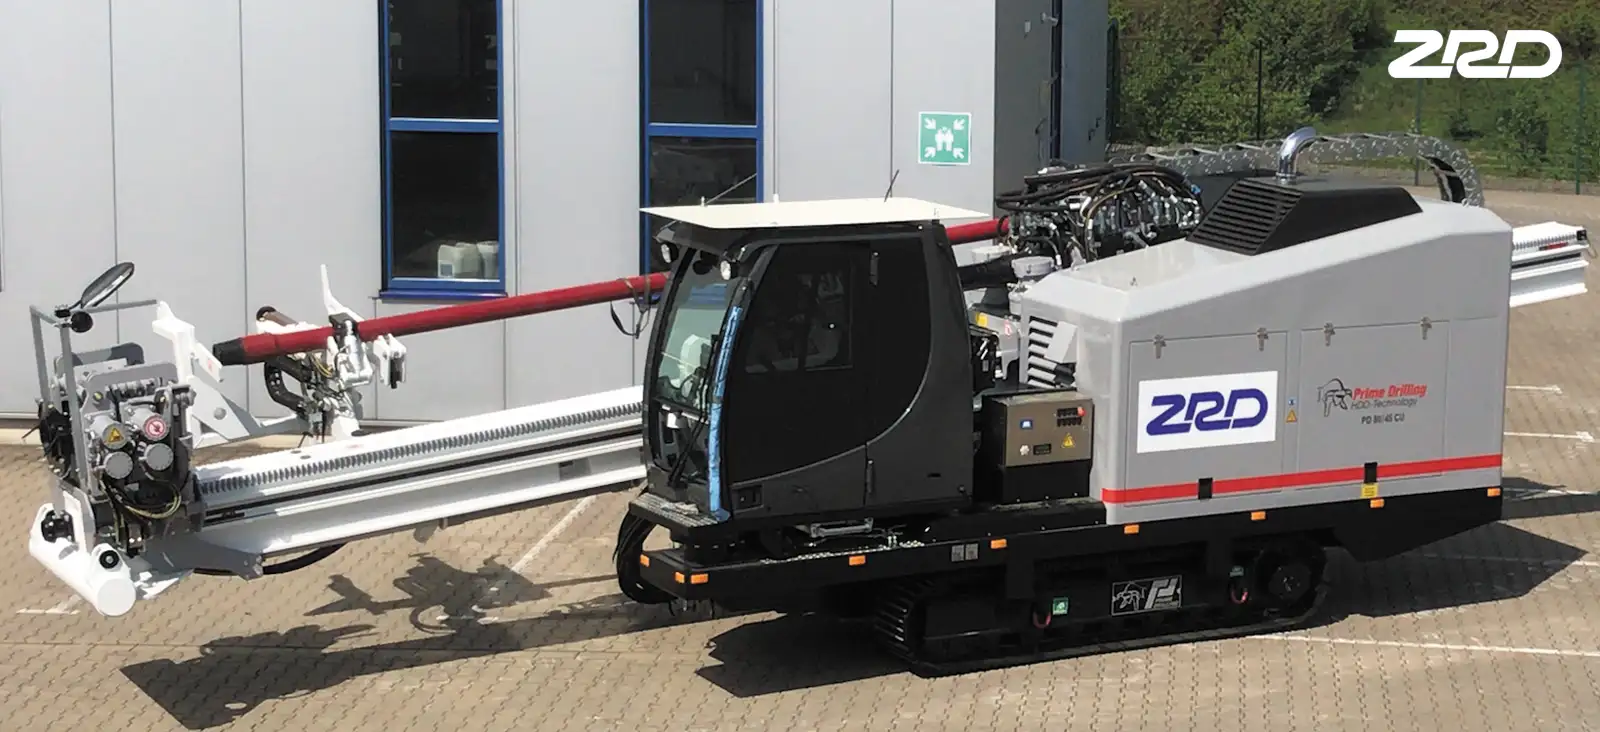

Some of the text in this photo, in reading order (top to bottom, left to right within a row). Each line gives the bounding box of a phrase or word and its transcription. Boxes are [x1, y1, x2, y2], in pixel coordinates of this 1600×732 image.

[1352, 384, 1427, 400] Prime Drilling
[1146, 388, 1268, 436] ZRD
